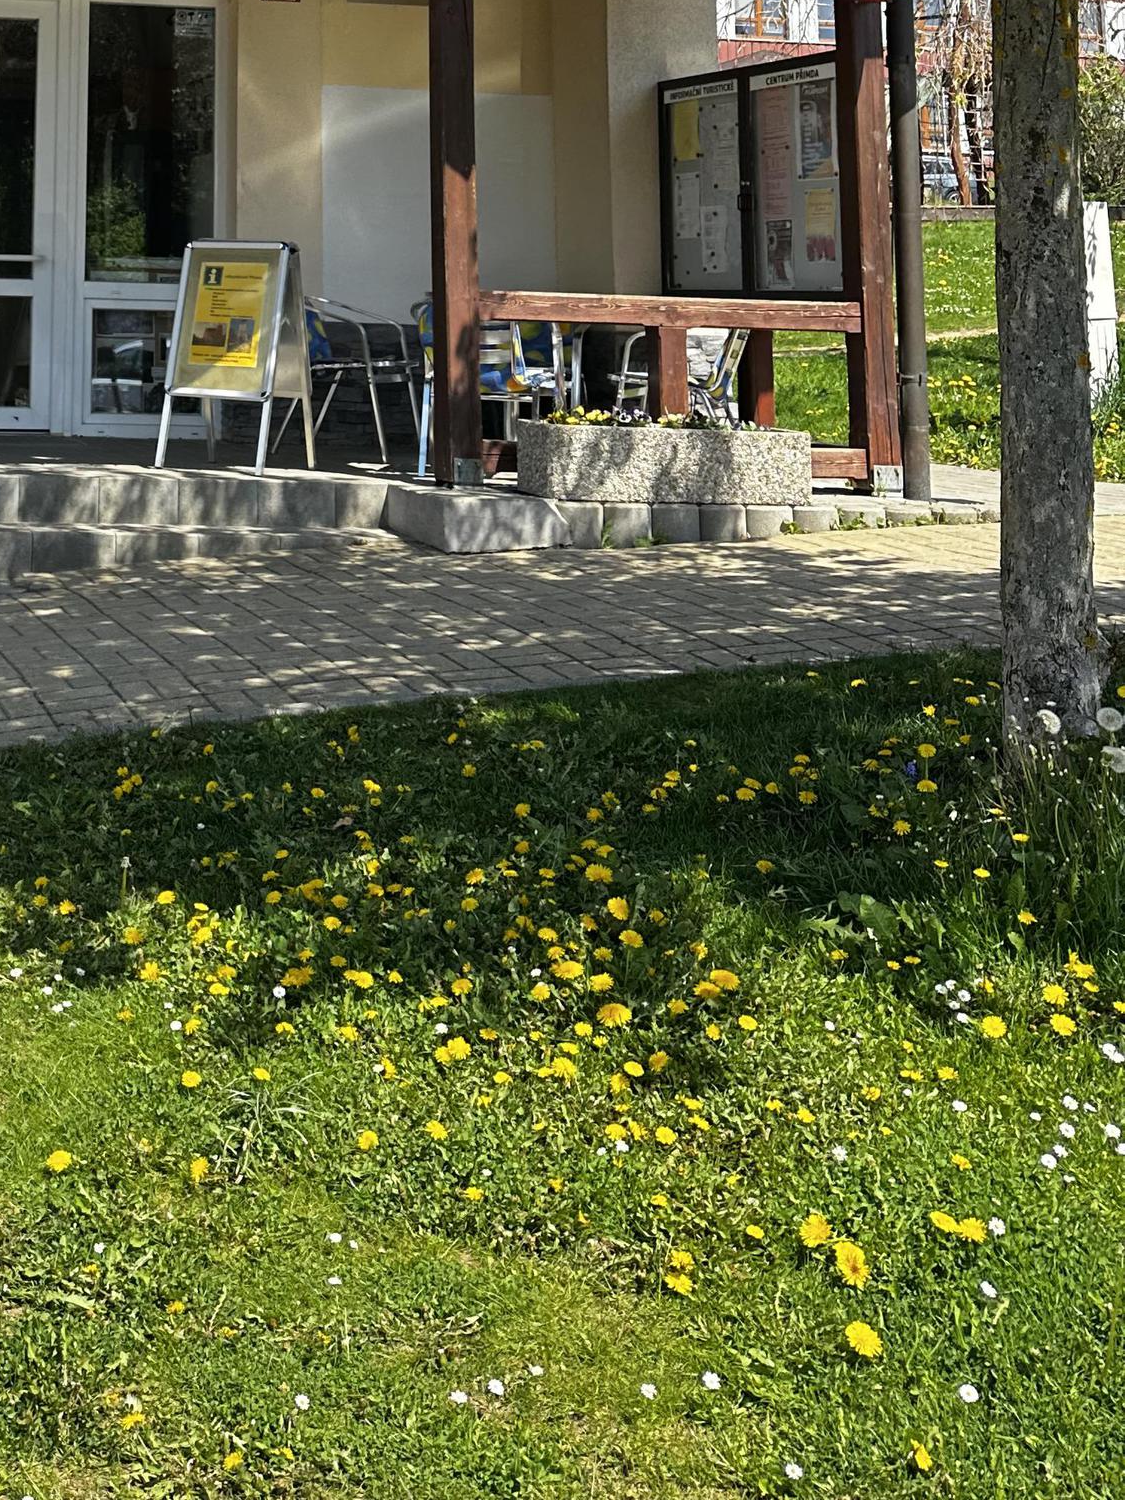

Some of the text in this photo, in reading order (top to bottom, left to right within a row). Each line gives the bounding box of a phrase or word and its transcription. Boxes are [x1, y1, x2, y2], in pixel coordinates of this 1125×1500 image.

[765, 68, 820, 86] CENTRUM PŘIMDA
[703, 82, 735, 96] TURISTICKÉ
